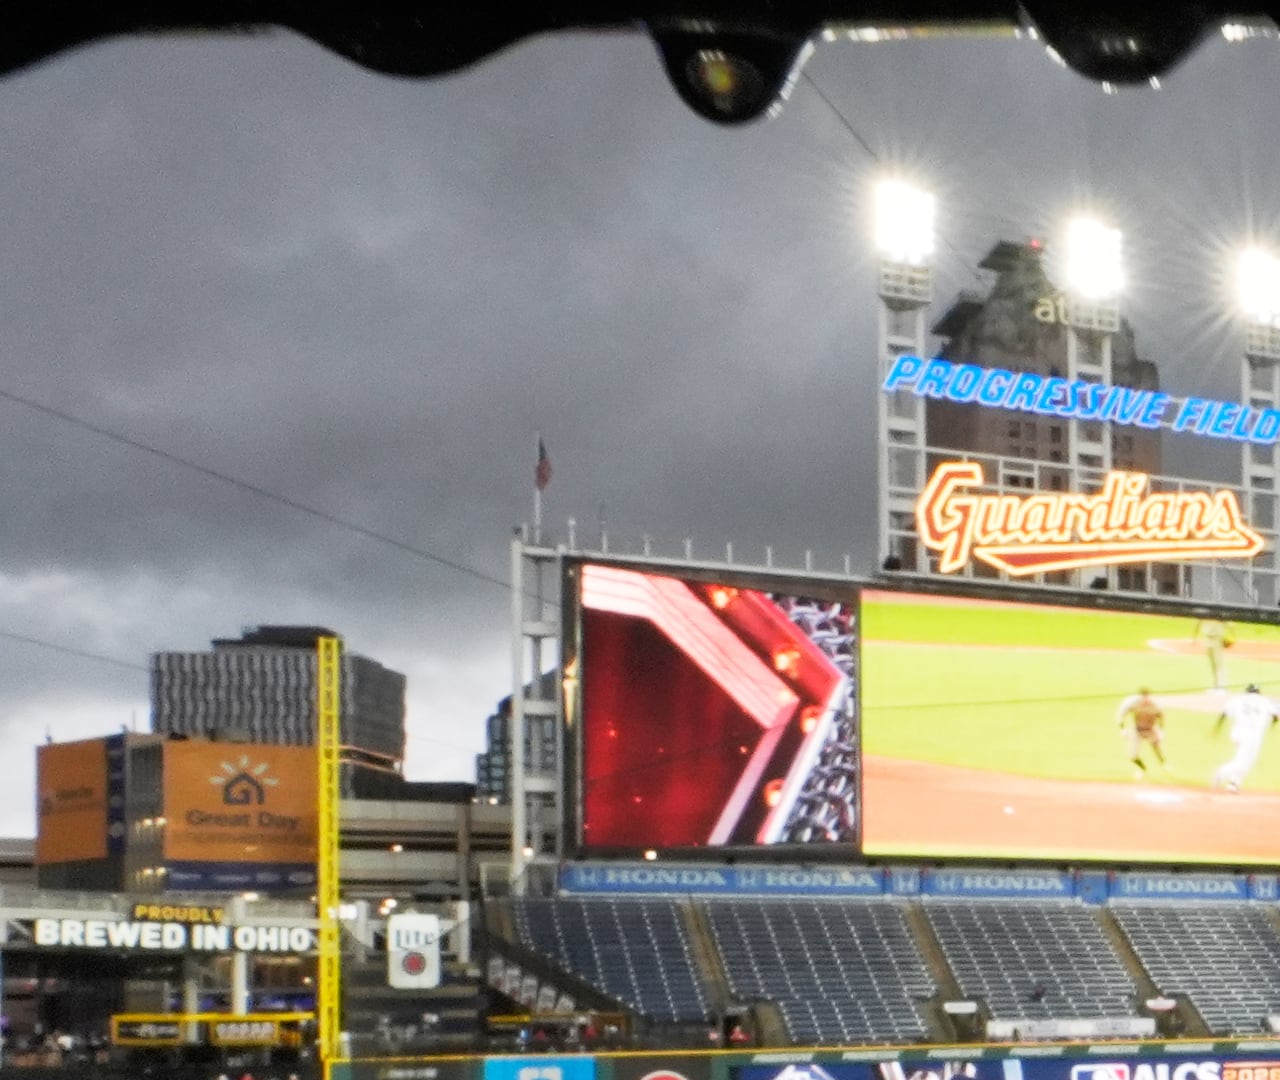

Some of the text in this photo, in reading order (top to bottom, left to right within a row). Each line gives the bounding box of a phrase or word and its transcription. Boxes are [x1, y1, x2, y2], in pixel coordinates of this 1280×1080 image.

[884, 354, 1170, 429] PROGRESSIVE
[917, 461, 1264, 576] Guardians
[186, 809, 250, 826] Great
[605, 869, 726, 887] HONDA
[764, 868, 877, 887] HONDA
[963, 874, 1064, 892] HONDA
[1146, 877, 1240, 895] HONDA
[134, 904, 224, 922] PROUDLY
[34, 917, 313, 952] BREWED IN OHIO
